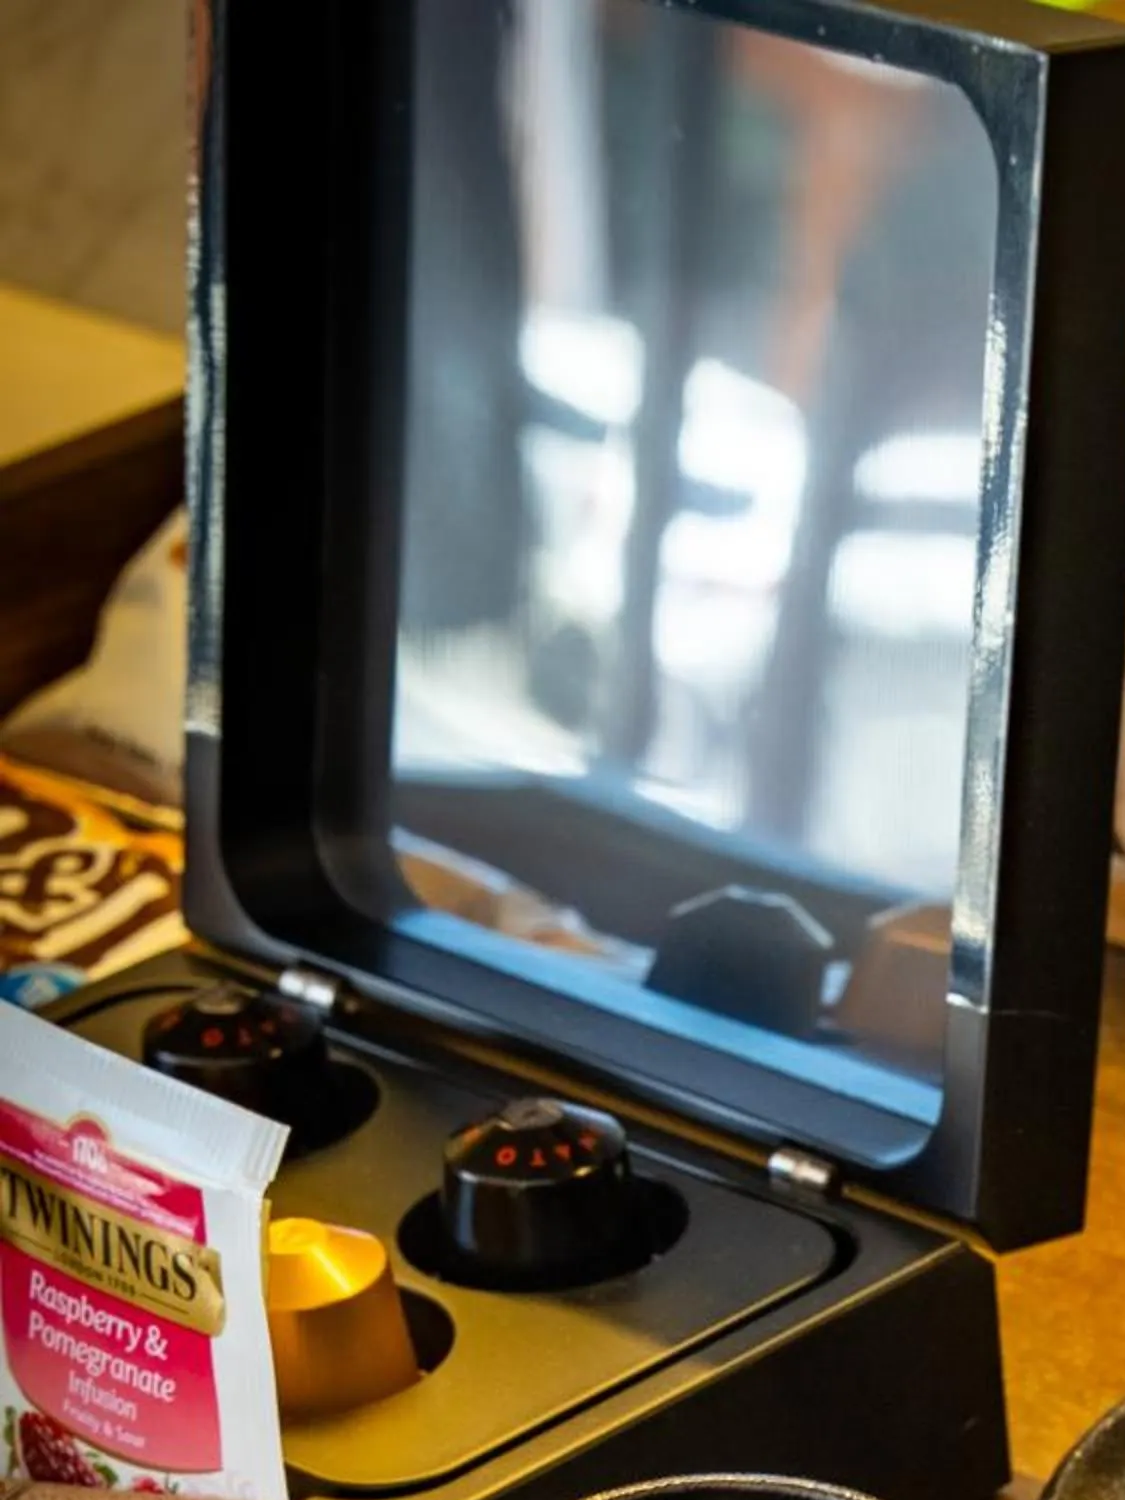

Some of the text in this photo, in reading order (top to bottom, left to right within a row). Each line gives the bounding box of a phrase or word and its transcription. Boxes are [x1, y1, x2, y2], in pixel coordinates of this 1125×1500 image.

[0, 1166, 197, 1303] TWININGS
[28, 1310, 177, 1402] Pomegranate
[29, 1269, 168, 1361] Raspberry &
[67, 1369, 137, 1422] Infusion
